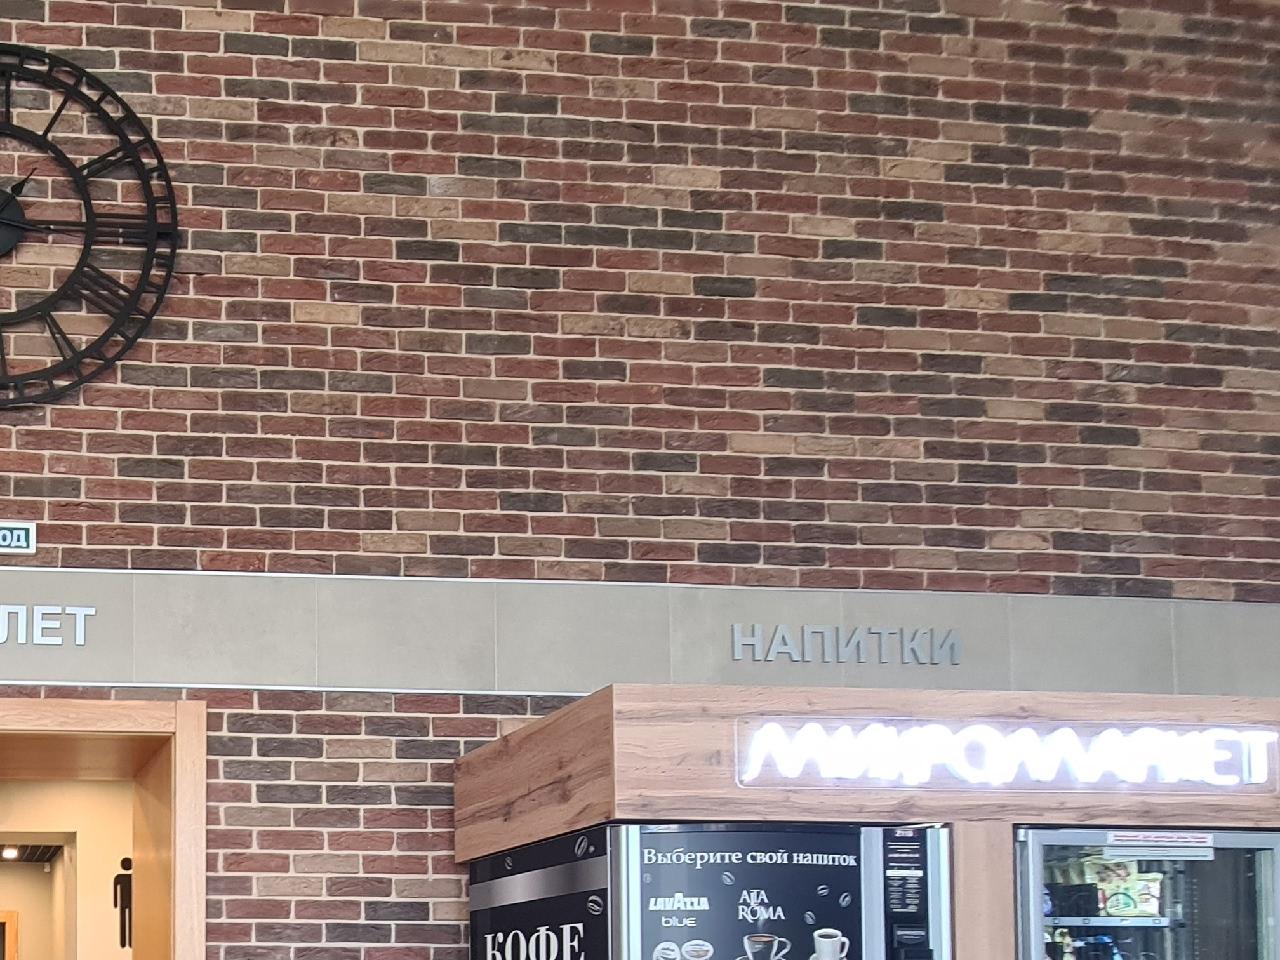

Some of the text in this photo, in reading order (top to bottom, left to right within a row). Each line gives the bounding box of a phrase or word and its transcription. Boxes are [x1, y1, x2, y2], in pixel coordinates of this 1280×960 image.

[731, 623, 962, 666] НАПИТКИ
[644, 848, 857, 869] Выберите свой напиток
[662, 916, 696, 927] blue
[737, 903, 785, 923] ROMA
